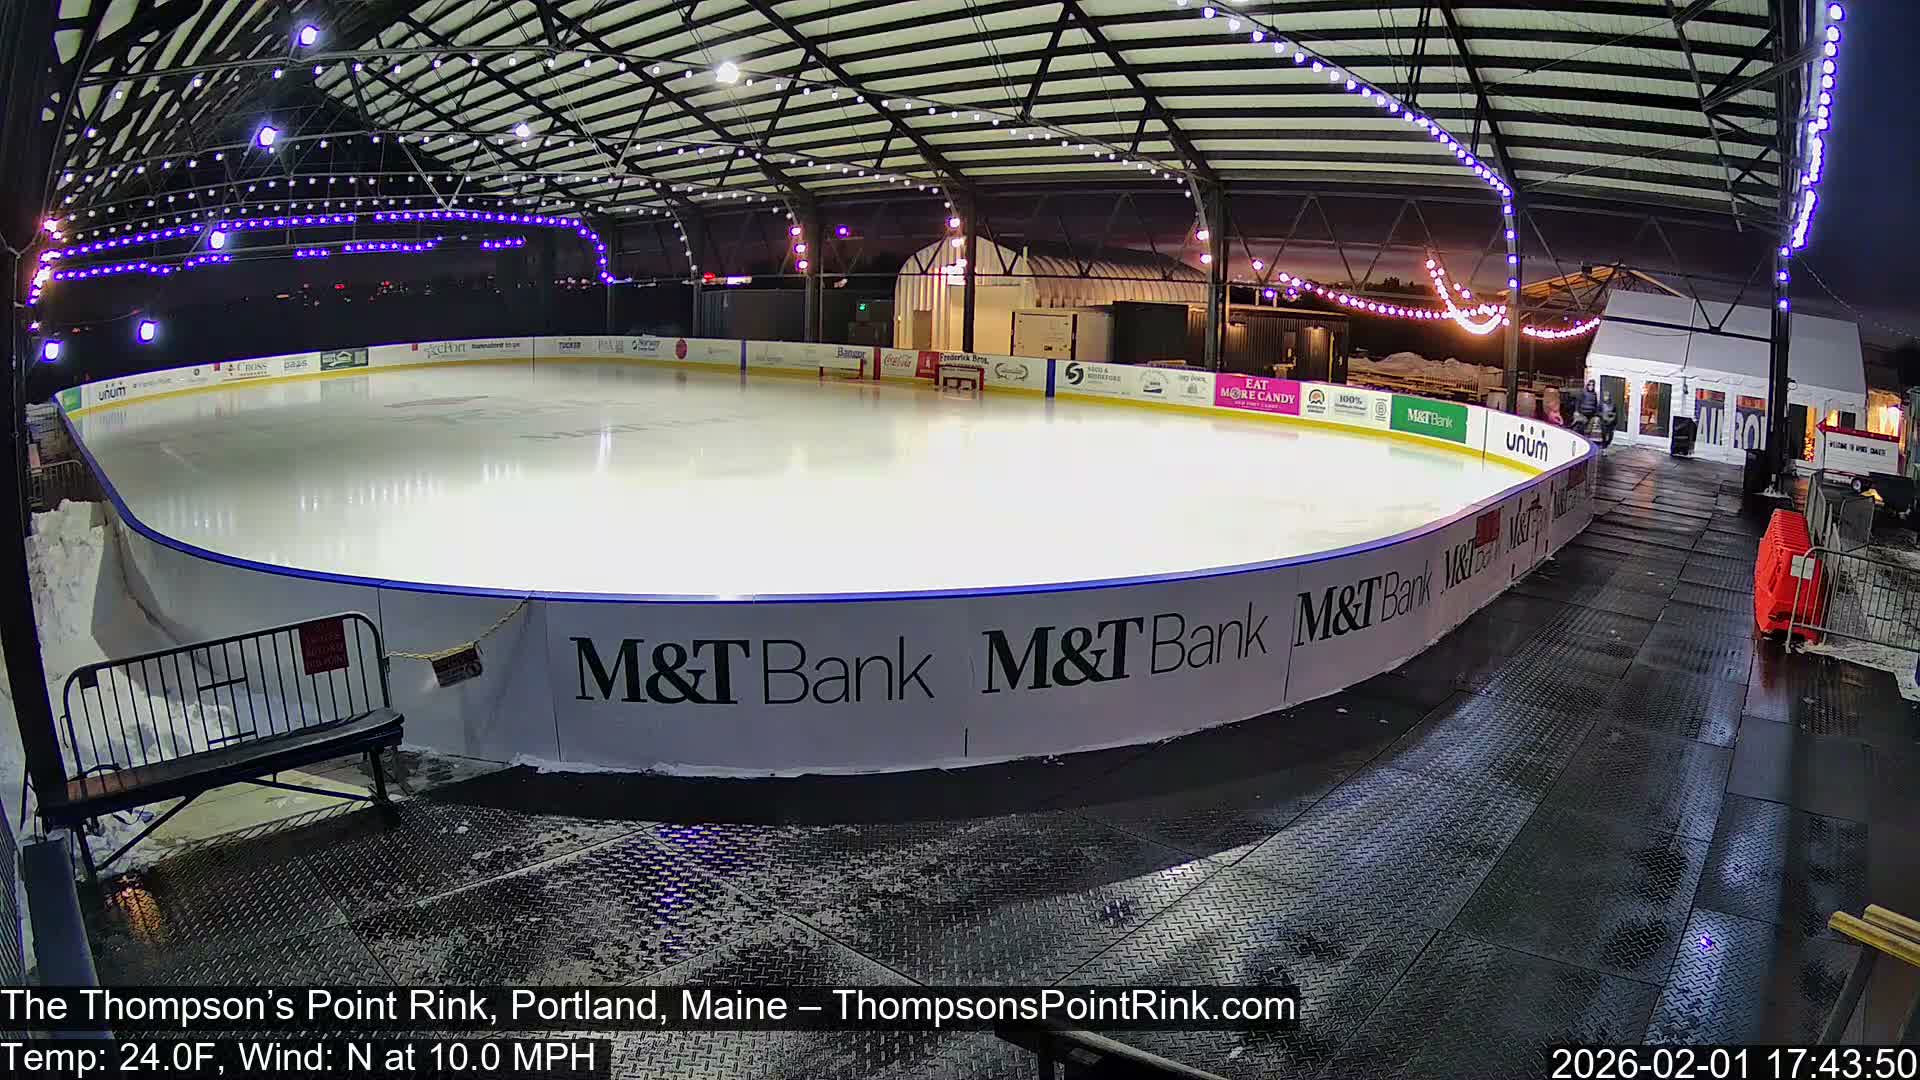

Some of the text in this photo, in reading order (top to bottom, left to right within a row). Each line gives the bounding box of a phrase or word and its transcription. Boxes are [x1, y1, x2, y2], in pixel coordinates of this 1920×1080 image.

[939, 352, 970, 362] Frederick
[1220, 387, 1256, 401] MORE
[1257, 390, 1297, 404] CANDY
[1245, 378, 1269, 391] EAT
[1407, 408, 1454, 428] M&T Bank
[1506, 424, 1548, 462] unum
[1441, 538, 1477, 593] M&T
[1294, 559, 1433, 648] M&T Bank
[982, 602, 1269, 694] M&T Bank
[569, 635, 935, 705] M&T Bank
